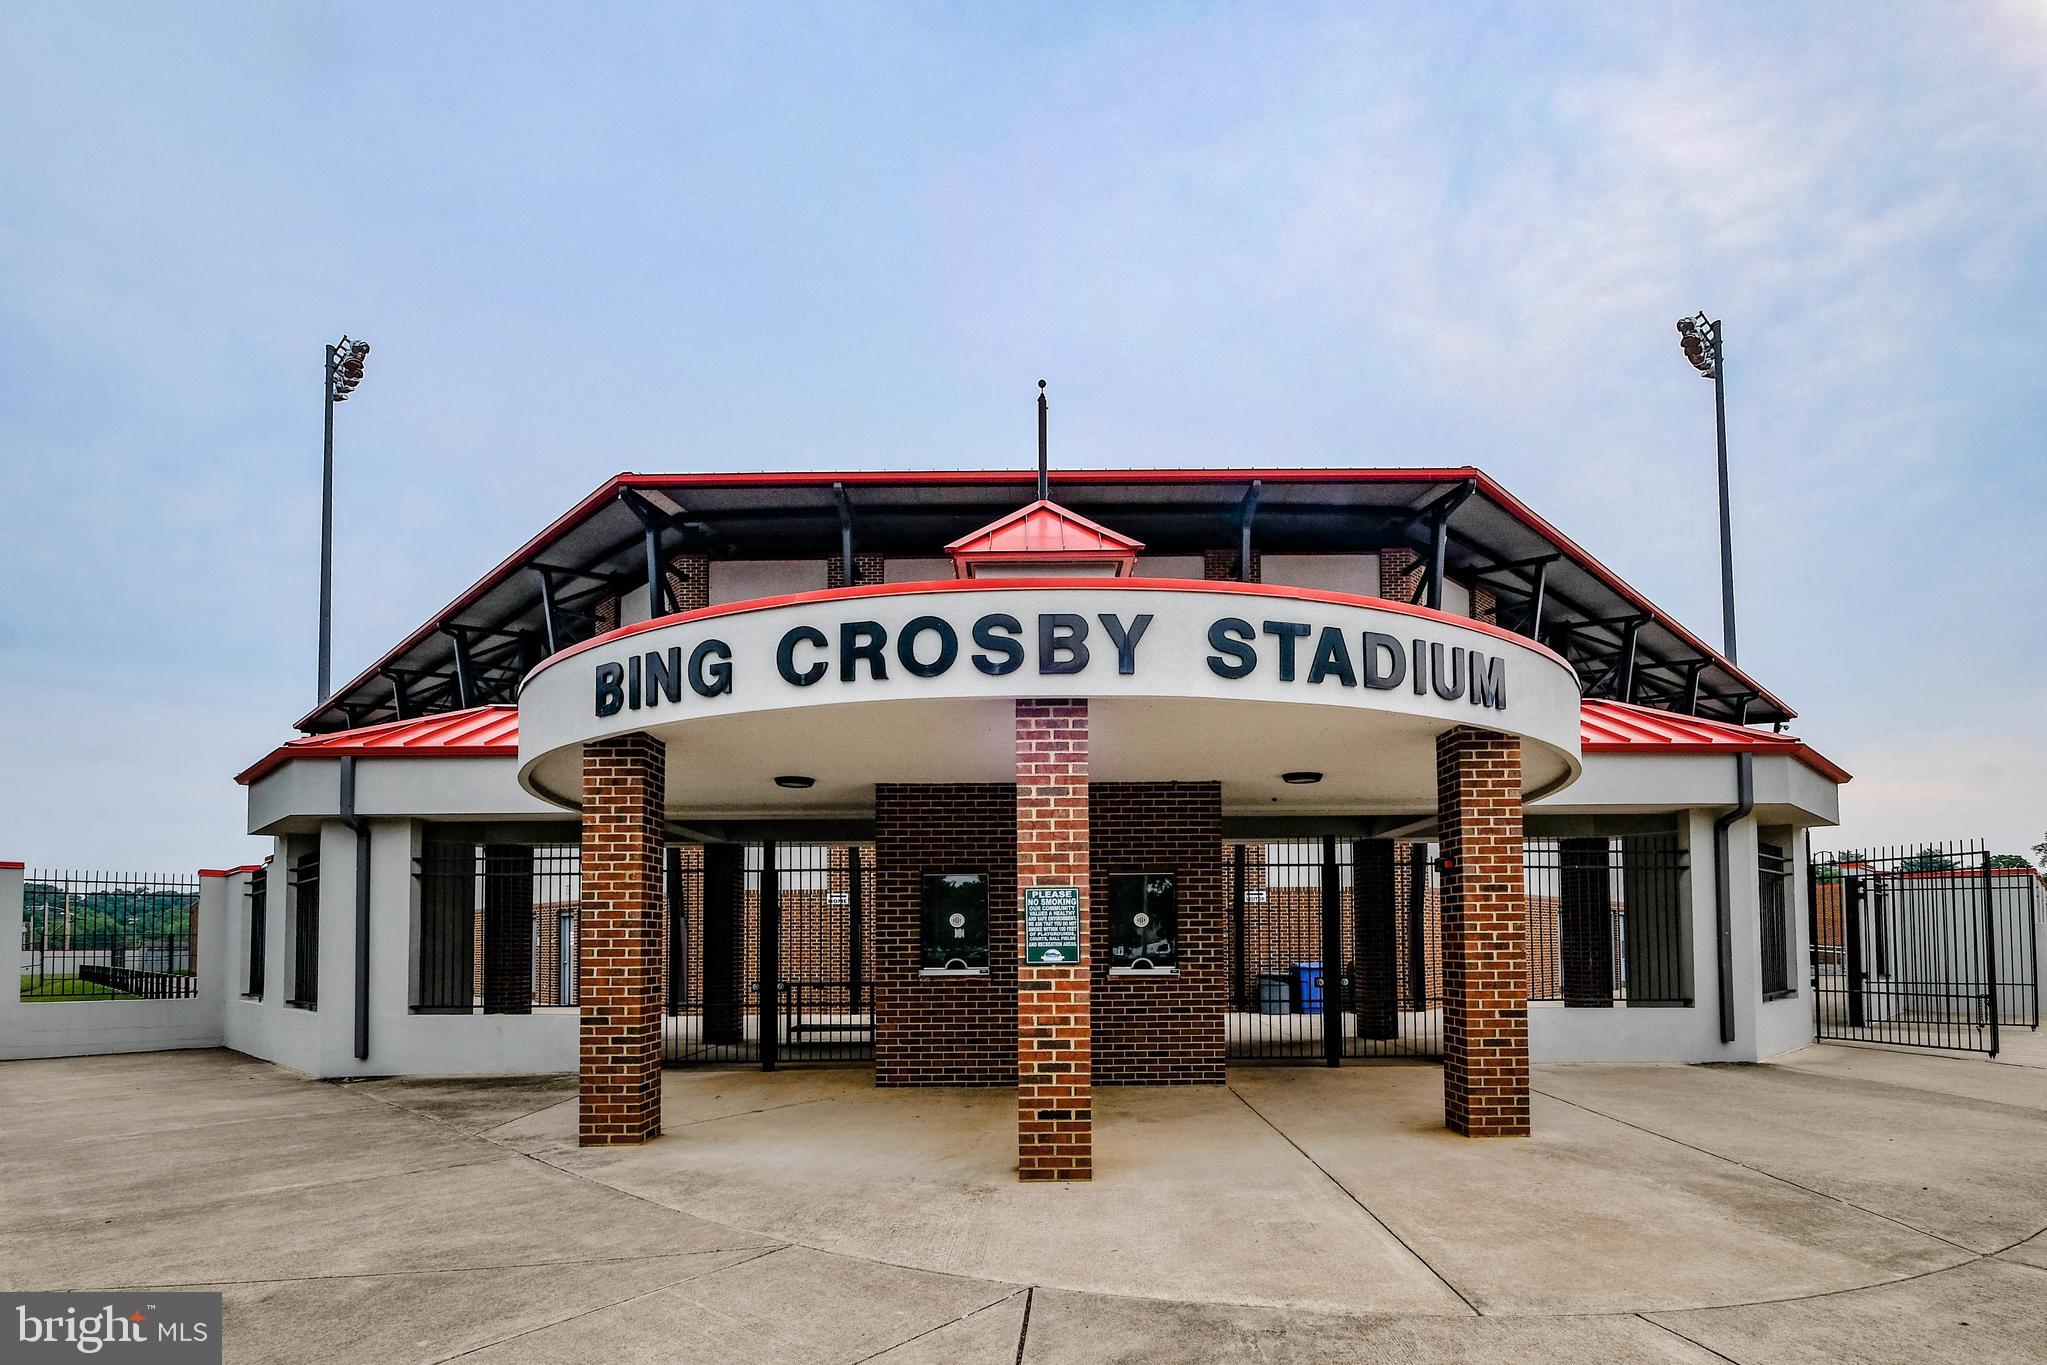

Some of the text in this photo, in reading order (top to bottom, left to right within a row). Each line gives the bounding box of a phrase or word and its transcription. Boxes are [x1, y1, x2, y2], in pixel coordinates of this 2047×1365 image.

[595, 613, 1507, 717] BING CROSBY STADIUM
